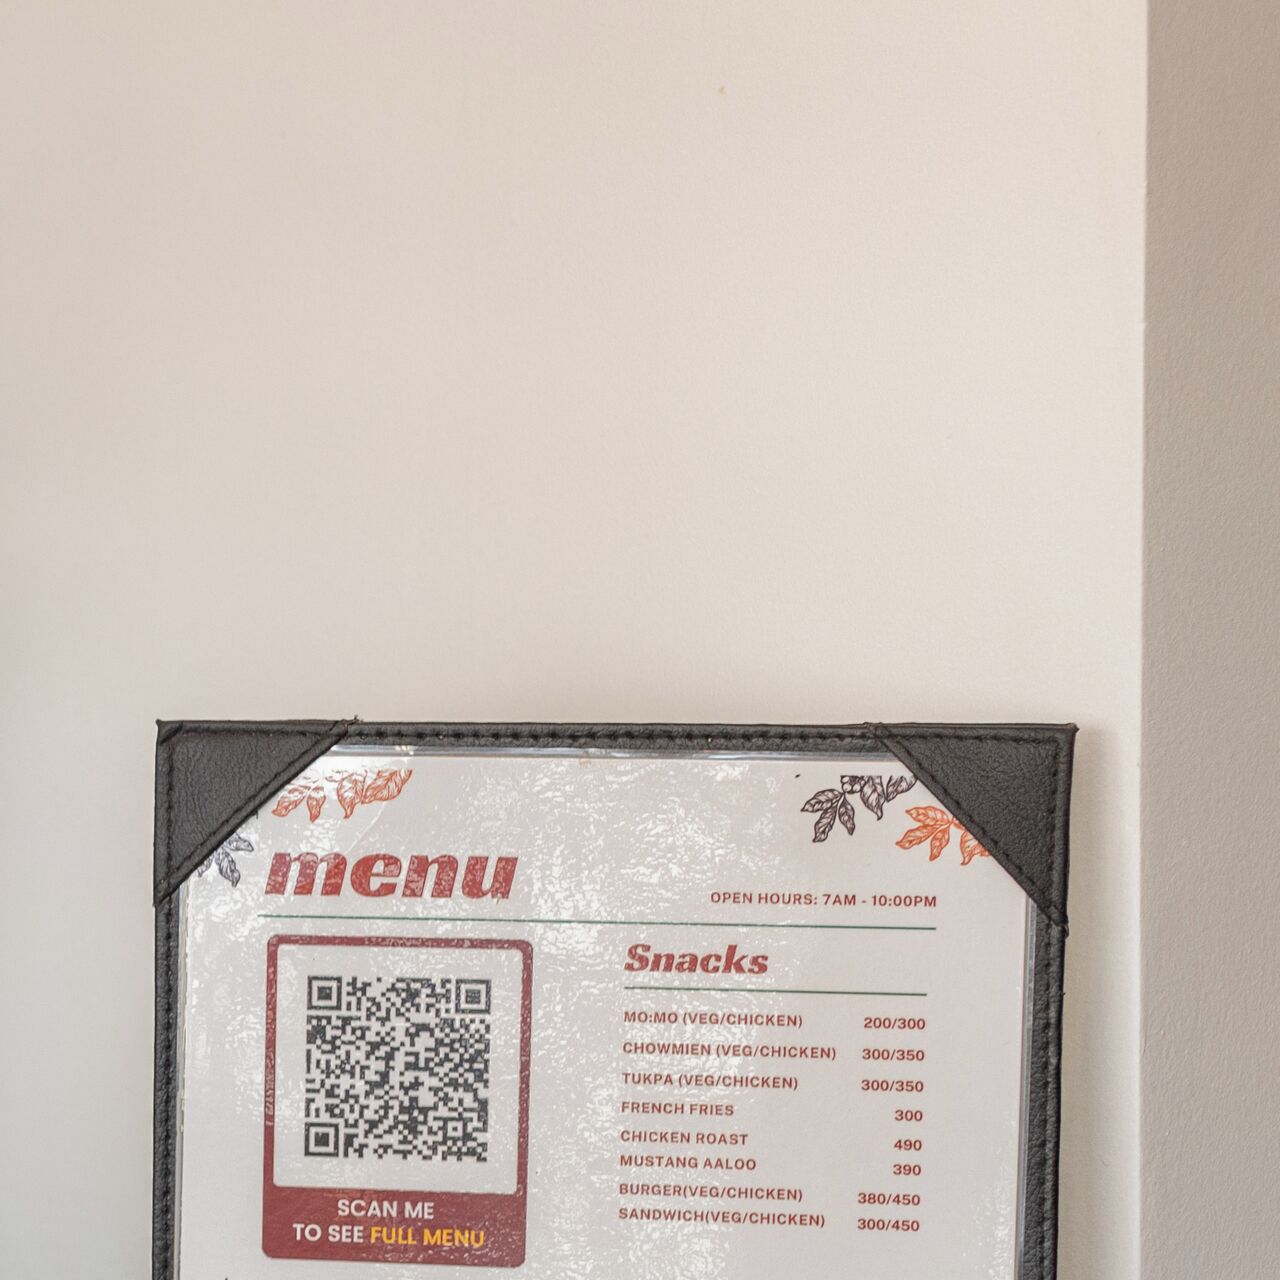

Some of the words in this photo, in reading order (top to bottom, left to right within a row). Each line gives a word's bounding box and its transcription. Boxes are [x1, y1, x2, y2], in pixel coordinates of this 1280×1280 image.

[264, 851, 518, 900] menu
[711, 892, 752, 904] OPEN
[758, 893, 818, 905] HOURS:
[823, 894, 856, 906] 7AM
[872, 895, 936, 907] 10:00PM
[624, 944, 768, 974] Snacks
[624, 1012, 677, 1024] MO:MO
[683, 1013, 802, 1029] (VEG/CHICKEN)
[864, 1017, 925, 1030] 200/300
[623, 1042, 710, 1055] CHOWMIEN
[716, 1044, 836, 1060] (VEG/CHICKEN)
[862, 1049, 925, 1061] 300/350
[622, 1073, 673, 1085] TUKPA
[679, 1074, 798, 1090] (VEG/CHICKEN)
[862, 1080, 924, 1092] 300/350
[621, 1102, 684, 1114] FRENCH
[690, 1104, 734, 1115] FRIES
[895, 1110, 923, 1122] 300
[621, 1131, 690, 1143] CHICKEN
[696, 1133, 748, 1145] ROAST
[894, 1140, 922, 1151] 490
[620, 1155, 698, 1168] MUSTANG
[703, 1158, 756, 1170] AALOO
[893, 1164, 921, 1176] 390
[619, 1184, 802, 1202] BURGER(VEG/CHICKEN)
[858, 1193, 921, 1206] 380/450
[338, 1200, 397, 1217] SCAN
[405, 1202, 434, 1219] ME
[619, 1208, 825, 1227] SANDWICH(VEG/CHICKEN)
[857, 1219, 919, 1232] 300/450
[293, 1224, 322, 1241] TO
[328, 1225, 363, 1243] SEE
[371, 1227, 416, 1245] FULL
[423, 1229, 484, 1247] MENU
